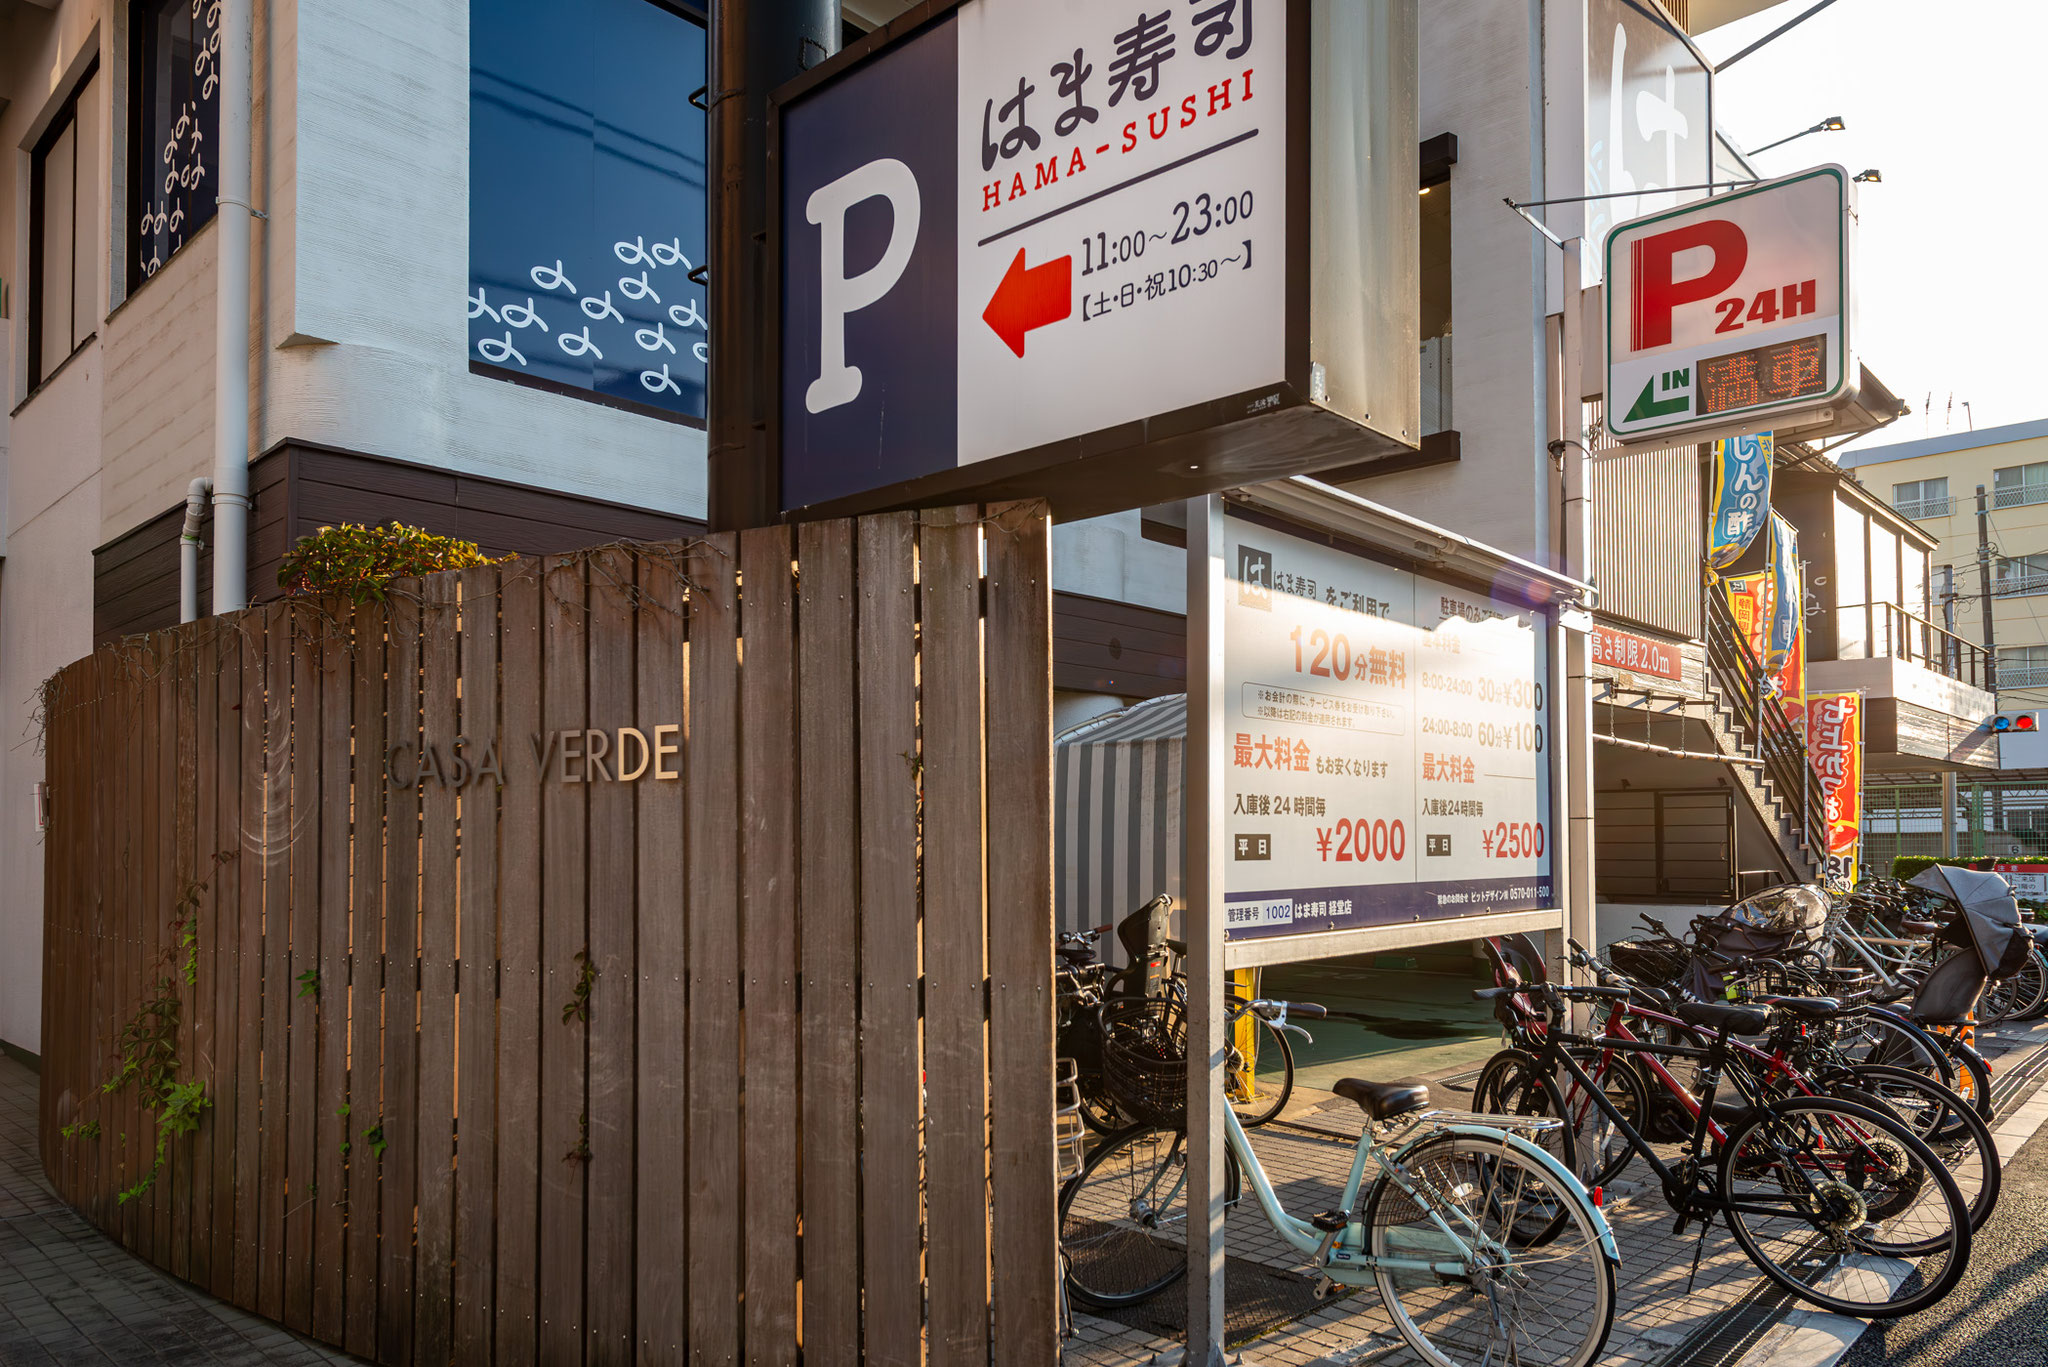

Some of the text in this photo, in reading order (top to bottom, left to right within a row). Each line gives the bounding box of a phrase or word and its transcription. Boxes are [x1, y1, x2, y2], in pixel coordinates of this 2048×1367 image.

[981, 0, 1253, 172] はま寿司
[982, 68, 1254, 213] HAMA-SUSHI
[805, 157, 922, 415] P
[1630, 219, 1748, 353] P
[1714, 279, 1817, 335] 24H
[1661, 367, 1690, 391] IN
[1706, 343, 1823, 414] 満車
[1243, 556, 1268, 600] は
[1273, 570, 1317, 600] はま寿司
[1289, 625, 1407, 689] 120分無料
[1422, 716, 1473, 739] 24:00-8:00
[384, 723, 680, 789] CASA VERDE
[1233, 732, 1389, 779] 最大料金 もお安くなります
[1422, 752, 1475, 784] 最大料金
[1422, 798, 1484, 818] 入庫後24時間毎
[1238, 838, 1267, 856] 平日
[1316, 817, 1406, 863] ¥2000
[1482, 821, 1545, 859] ¥2500
[1227, 906, 1260, 923] 管理番号
[1266, 904, 1291, 920] 1002
[1509, 886, 1550, 900] 0570-011-500
